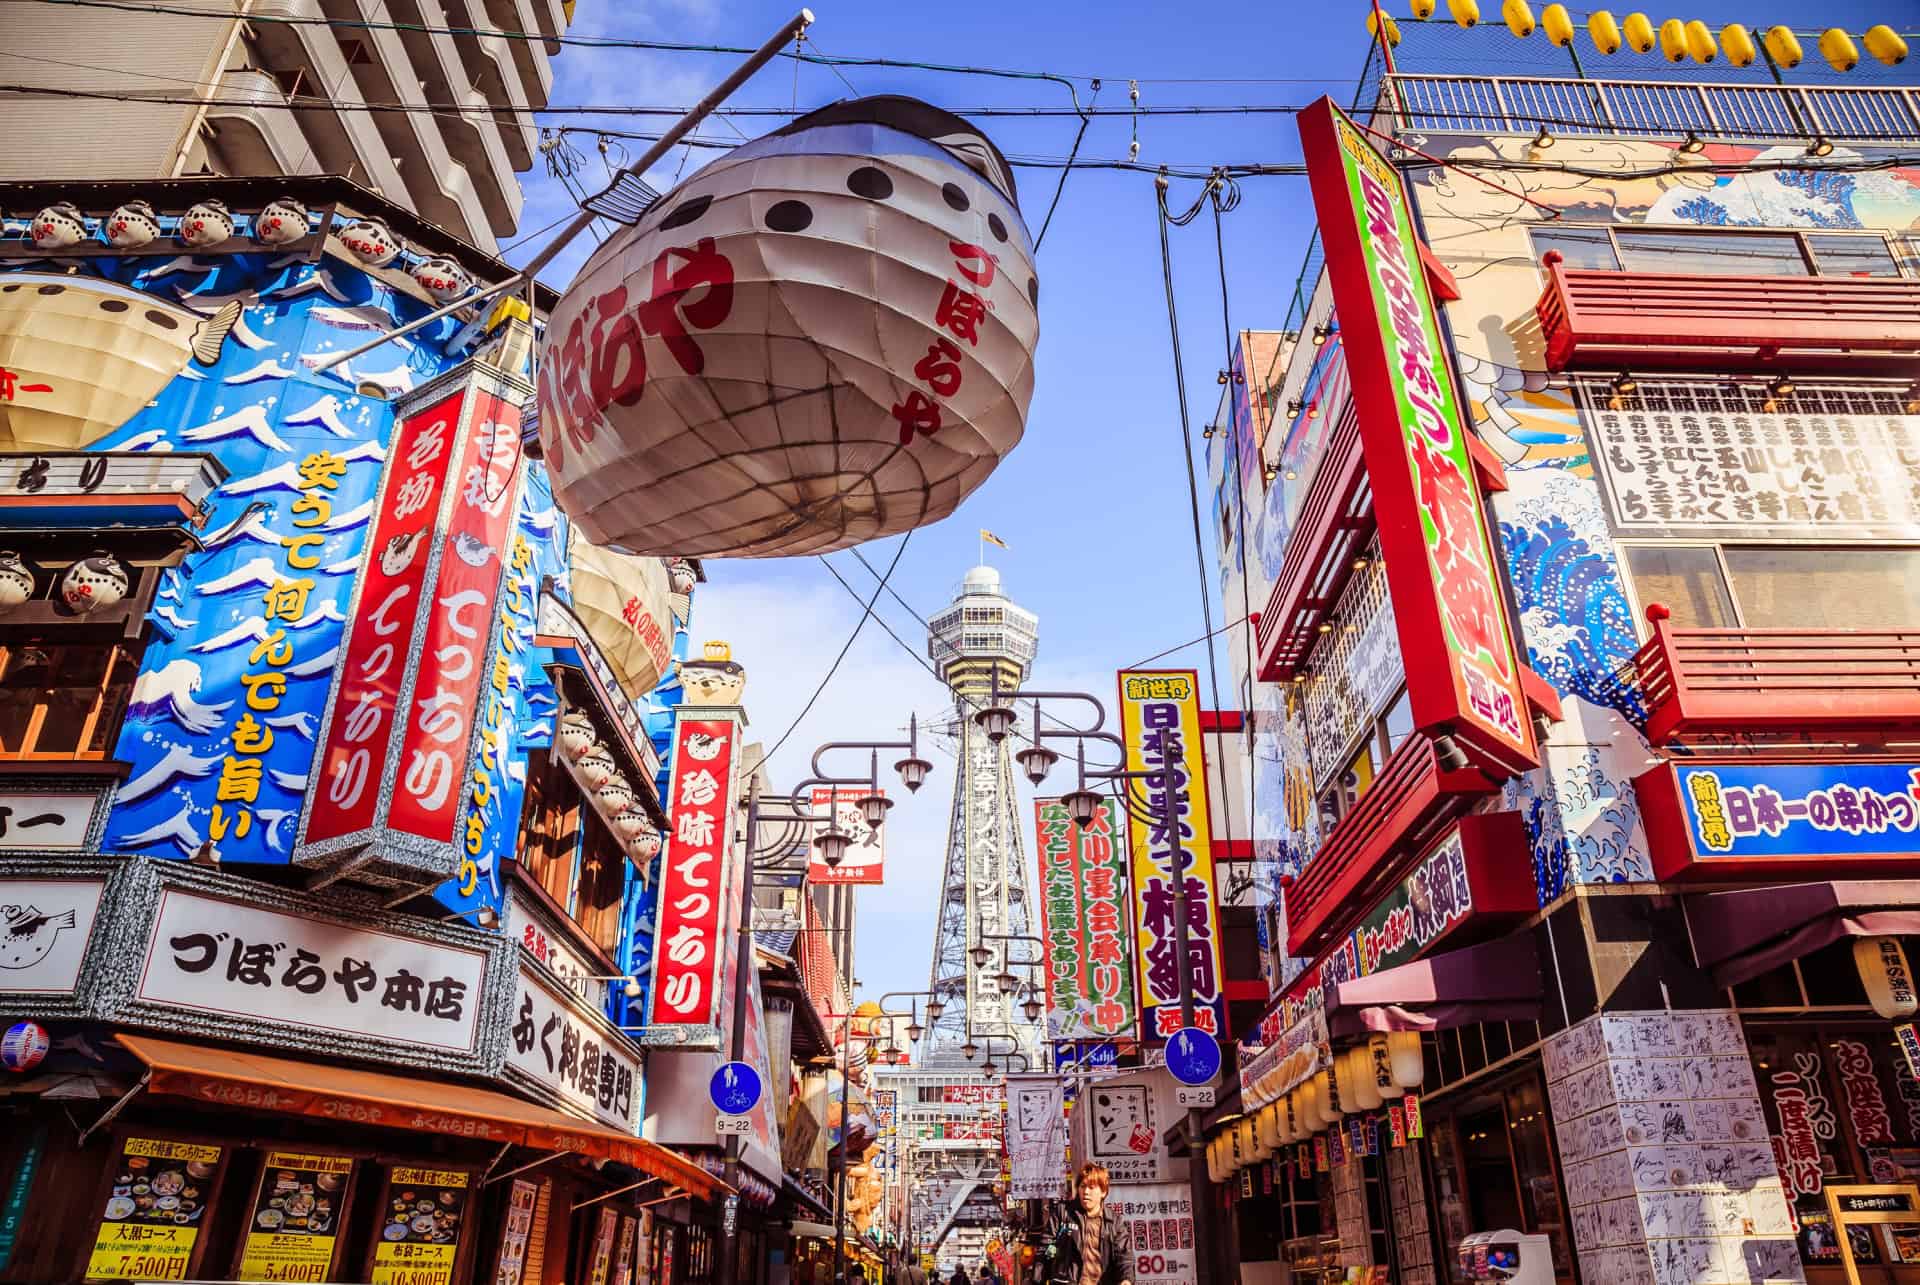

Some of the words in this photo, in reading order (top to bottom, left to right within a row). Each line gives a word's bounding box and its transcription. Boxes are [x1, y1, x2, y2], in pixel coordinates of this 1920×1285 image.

[892, 240, 1001, 446] づぼらや
[1358, 168, 1451, 448] 日本一の串かつ
[1609, 445, 1648, 520] もち
[1661, 446, 1703, 520] 紅しょうが
[1688, 447, 1728, 521] にんにく
[1714, 446, 1755, 520] 玉ねぎ
[1793, 447, 1839, 521] れんこん
[1412, 428, 1512, 682] 横綱
[209, 450, 347, 842] 安うて何んでも旨い
[1127, 678, 1191, 699] 新世界
[1691, 774, 1731, 847] 新世界
[1725, 787, 1914, 833] 日本一の串かつ
[664, 768, 719, 1014] 珍味てっちり
[169, 930, 468, 1022] づぼらや本店
[1142, 878, 1218, 1003] 横綱
[511, 990, 633, 1118] ふぐ料理専門
[717, 1120, 750, 1131] 9-22
[1179, 1091, 1213, 1103] 9-22
[1771, 1071, 1823, 1195] 二度漬け
[1794, 1052, 1837, 1140] ソースの
[115, 1224, 177, 1241] 大黒コース
[118, 1255, 185, 1278] 7,500円
[263, 1263, 325, 1282] 5,400円
[390, 1271, 447, 1285] 10,800円
